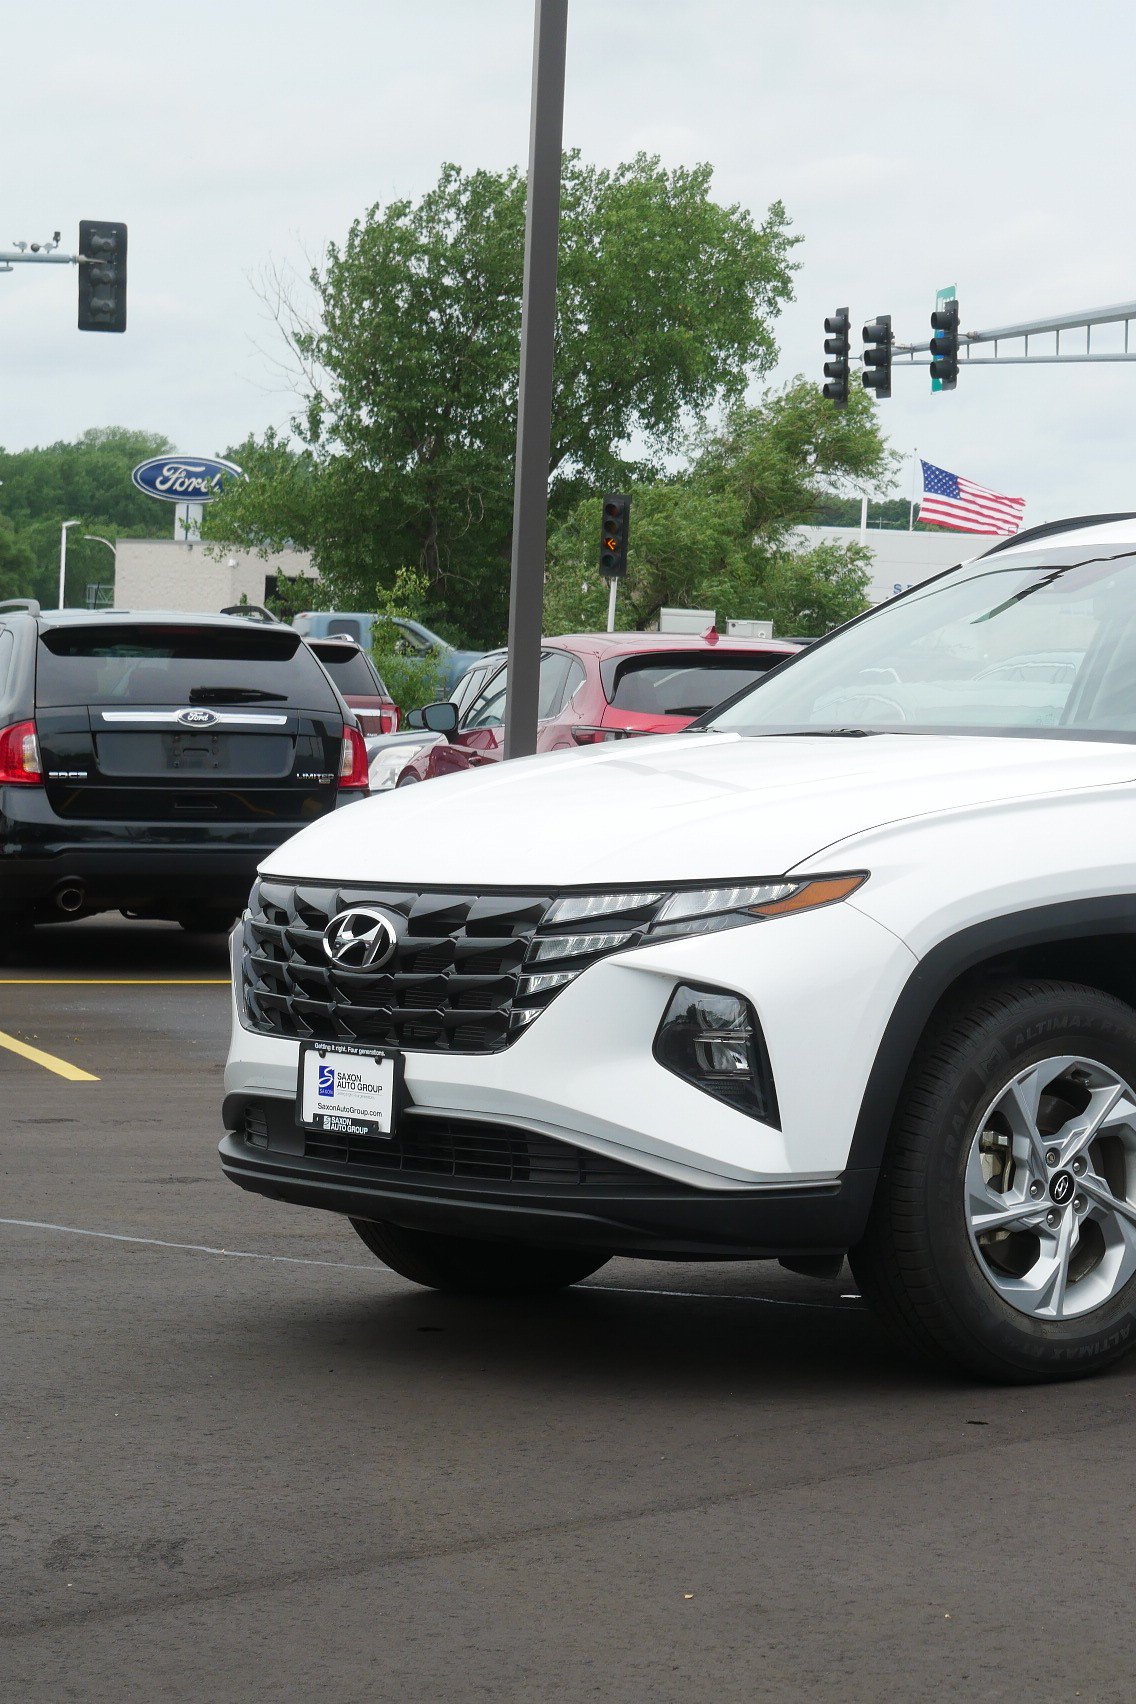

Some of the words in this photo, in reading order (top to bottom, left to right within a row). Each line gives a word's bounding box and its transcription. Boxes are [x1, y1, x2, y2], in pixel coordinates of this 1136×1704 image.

[188, 712, 209, 721] Ford
[347, 1046, 358, 1054] Four
[337, 1072, 362, 1083] SAXON
[336, 1080, 356, 1091] AUTO
[356, 1082, 383, 1094] GROUP
[317, 1102, 383, 1118] SaxonAutoGroup.com
[331, 1116, 352, 1126] SAXON
[330, 1123, 347, 1132] AUTO
[346, 1125, 369, 1135] GROUP
